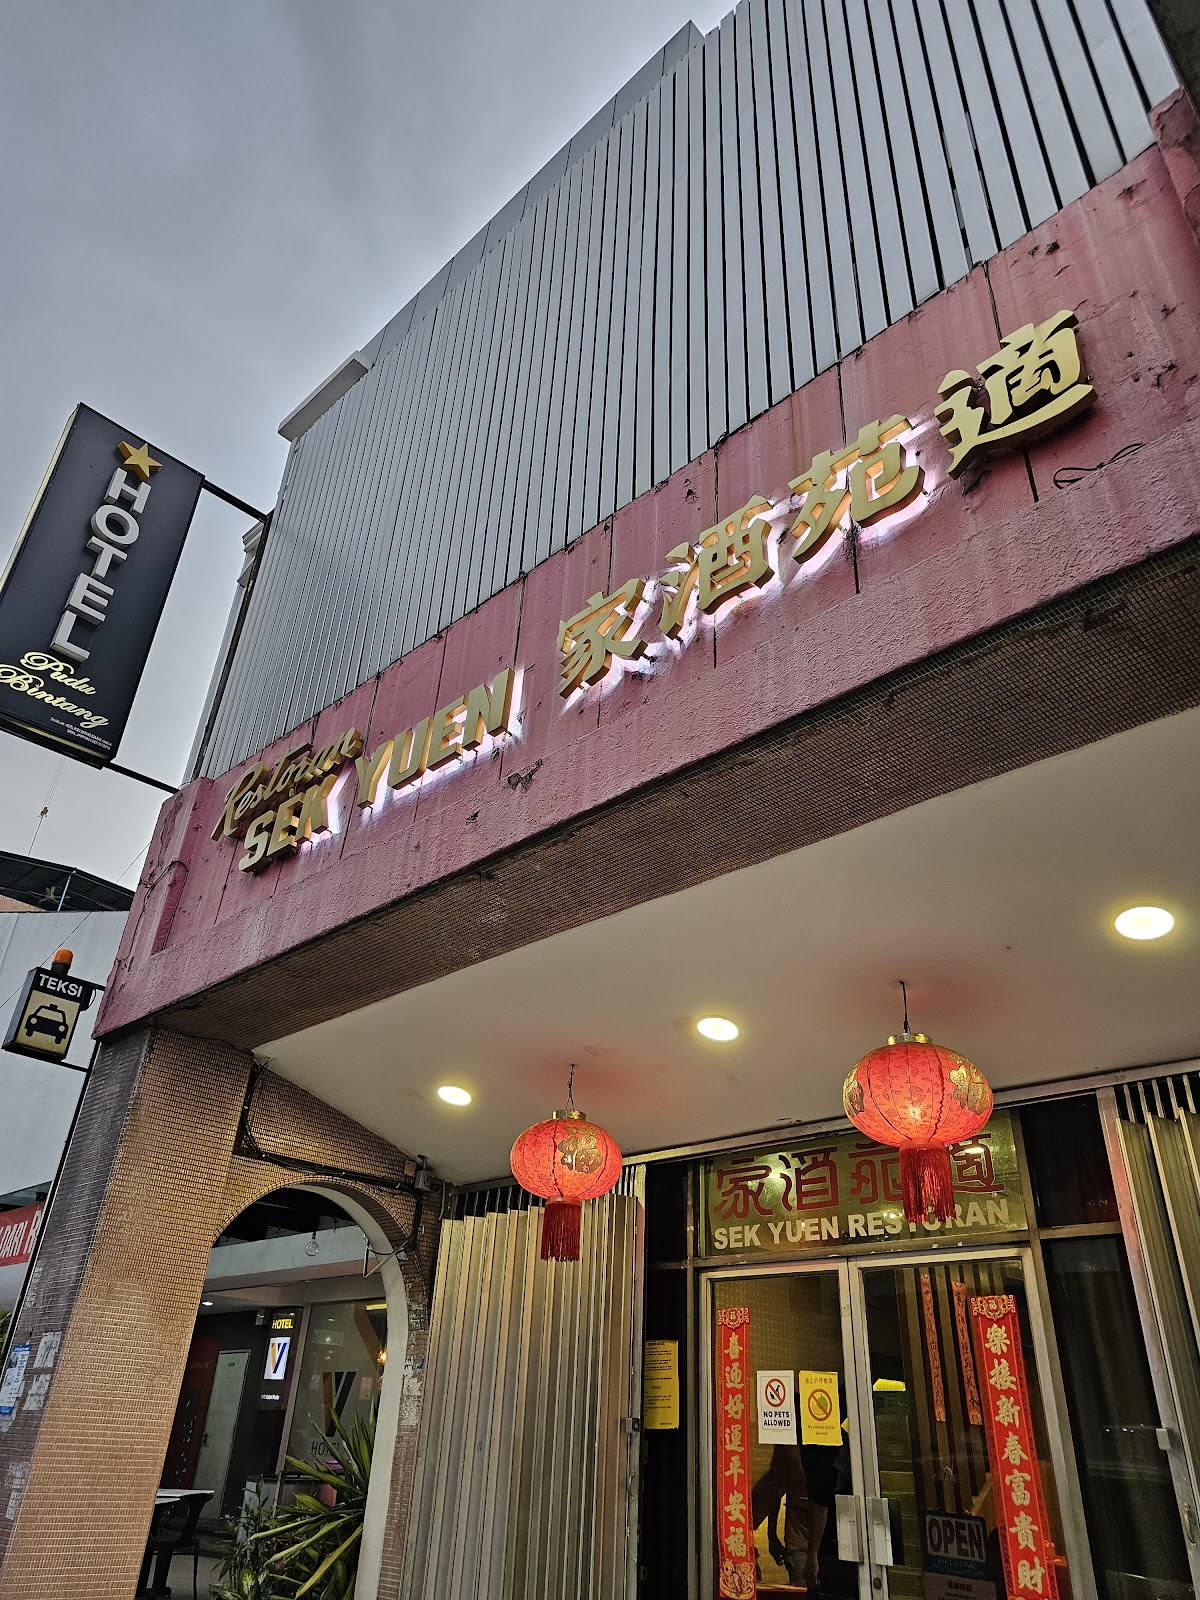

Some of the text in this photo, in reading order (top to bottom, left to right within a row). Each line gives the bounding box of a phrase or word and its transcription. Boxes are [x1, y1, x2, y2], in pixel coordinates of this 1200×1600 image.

[50, 467, 152, 664] HOTEL
[20, 651, 97, 695] Pudu
[0, 663, 109, 729] Bintang
[210, 727, 363, 841] Restoran
[239, 668, 515, 873] SEK YUEN
[39, 973, 83, 998] TEKSI
[714, 1223, 761, 1250] SEK
[769, 1215, 841, 1247] YUEN
[272, 1318, 294, 1330] HOTEL
[763, 1410, 790, 1418] NO PETS
[763, 1419, 791, 1427] ALLOWED
[928, 1517, 984, 1560] OPEN
